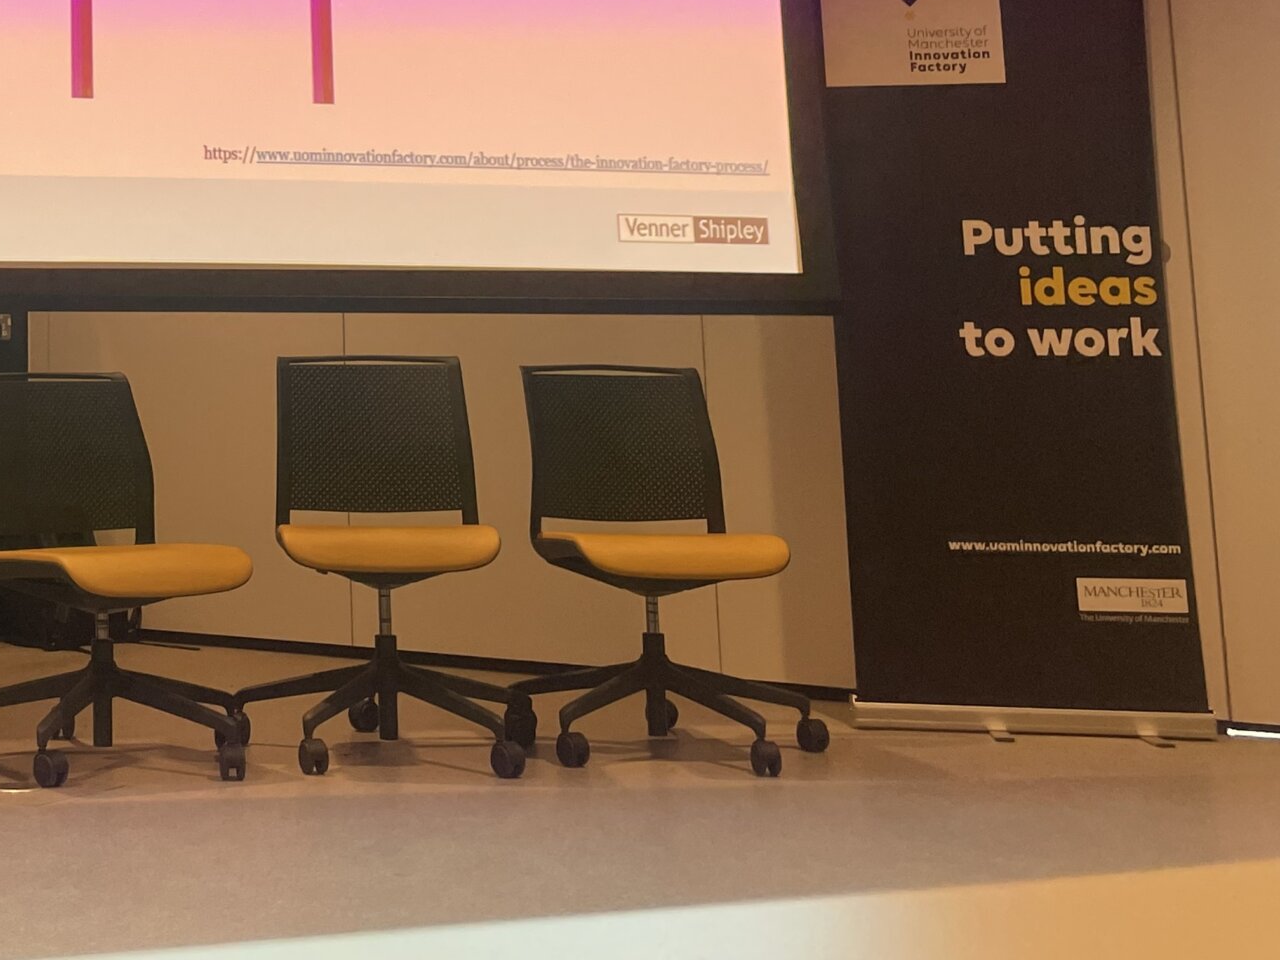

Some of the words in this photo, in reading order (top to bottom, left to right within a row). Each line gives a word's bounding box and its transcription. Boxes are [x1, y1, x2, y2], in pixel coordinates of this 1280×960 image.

[907, 27, 972, 39] University
[974, 25, 987, 36] of
[908, 39, 989, 49] Manchester
[909, 48, 990, 61] Innovation
[910, 62, 967, 74] Factory
[624, 217, 689, 238] Venner
[698, 219, 765, 243] Shipley
[961, 214, 1153, 265] Putting
[1018, 266, 1158, 306] ideas
[959, 321, 1015, 357] to
[1027, 316, 1162, 357] work
[948, 539, 1181, 556] www.uominnovationfactory.com
[1084, 585, 1183, 599] MANCHESTER
